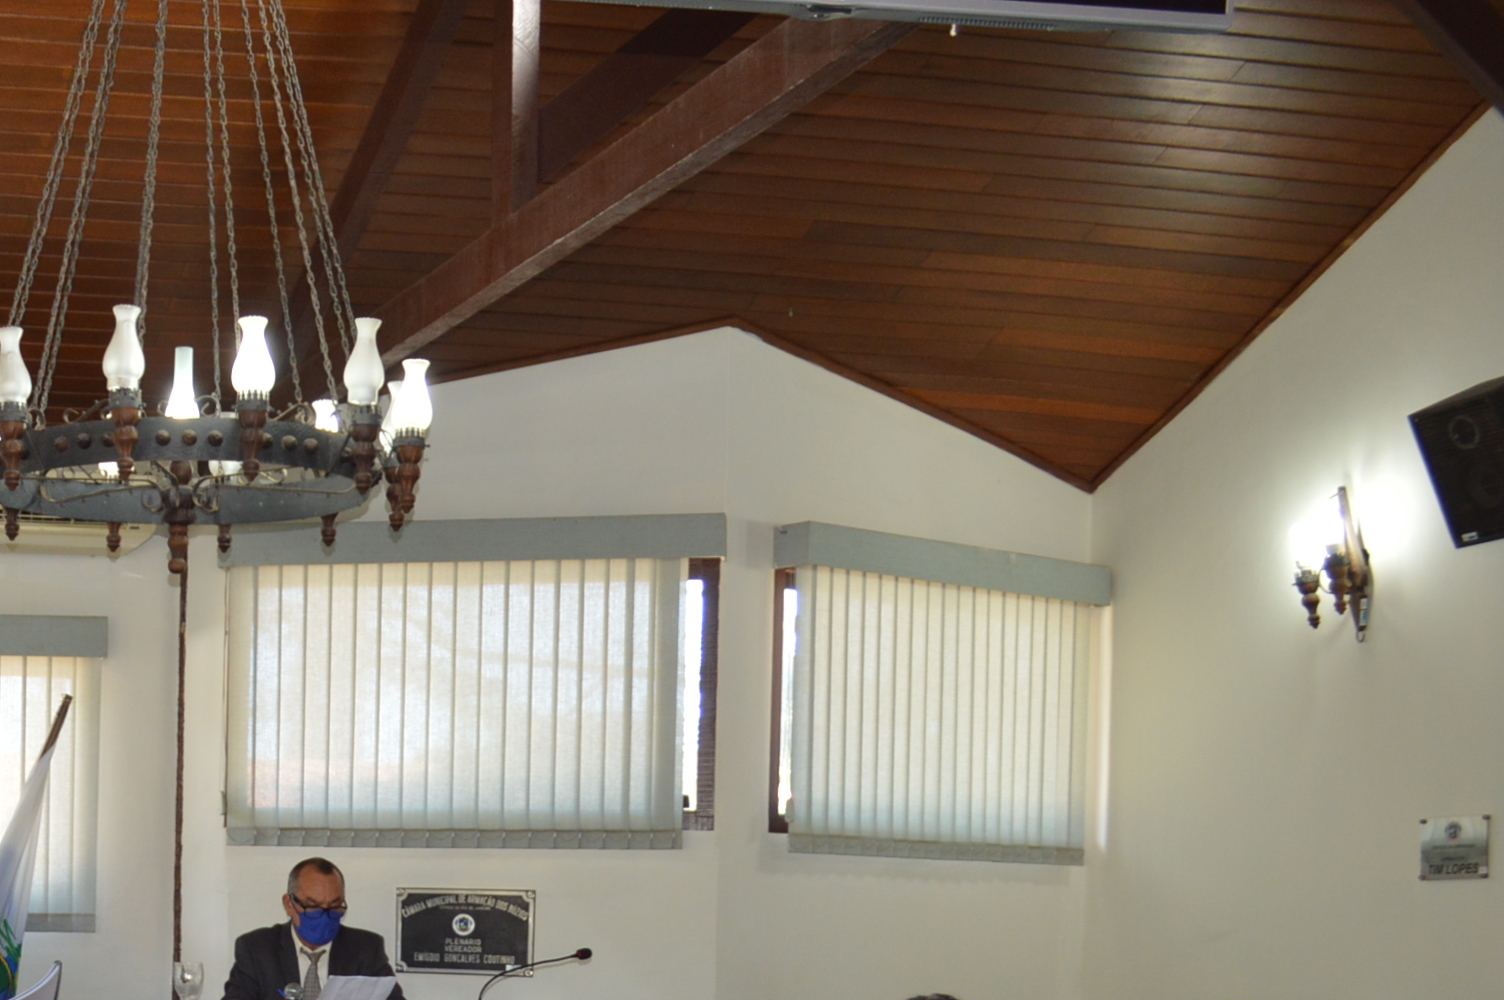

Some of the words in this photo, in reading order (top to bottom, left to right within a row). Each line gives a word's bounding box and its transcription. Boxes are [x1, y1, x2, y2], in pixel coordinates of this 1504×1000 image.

[1445, 862, 1479, 874] LOPES
[426, 895, 457, 908] MUNICIPAL
[458, 894, 466, 903] DE
[495, 899, 508, 911] DOS
[444, 945, 482, 953] VEREADOR
[483, 954, 515, 964] COUTINHO
